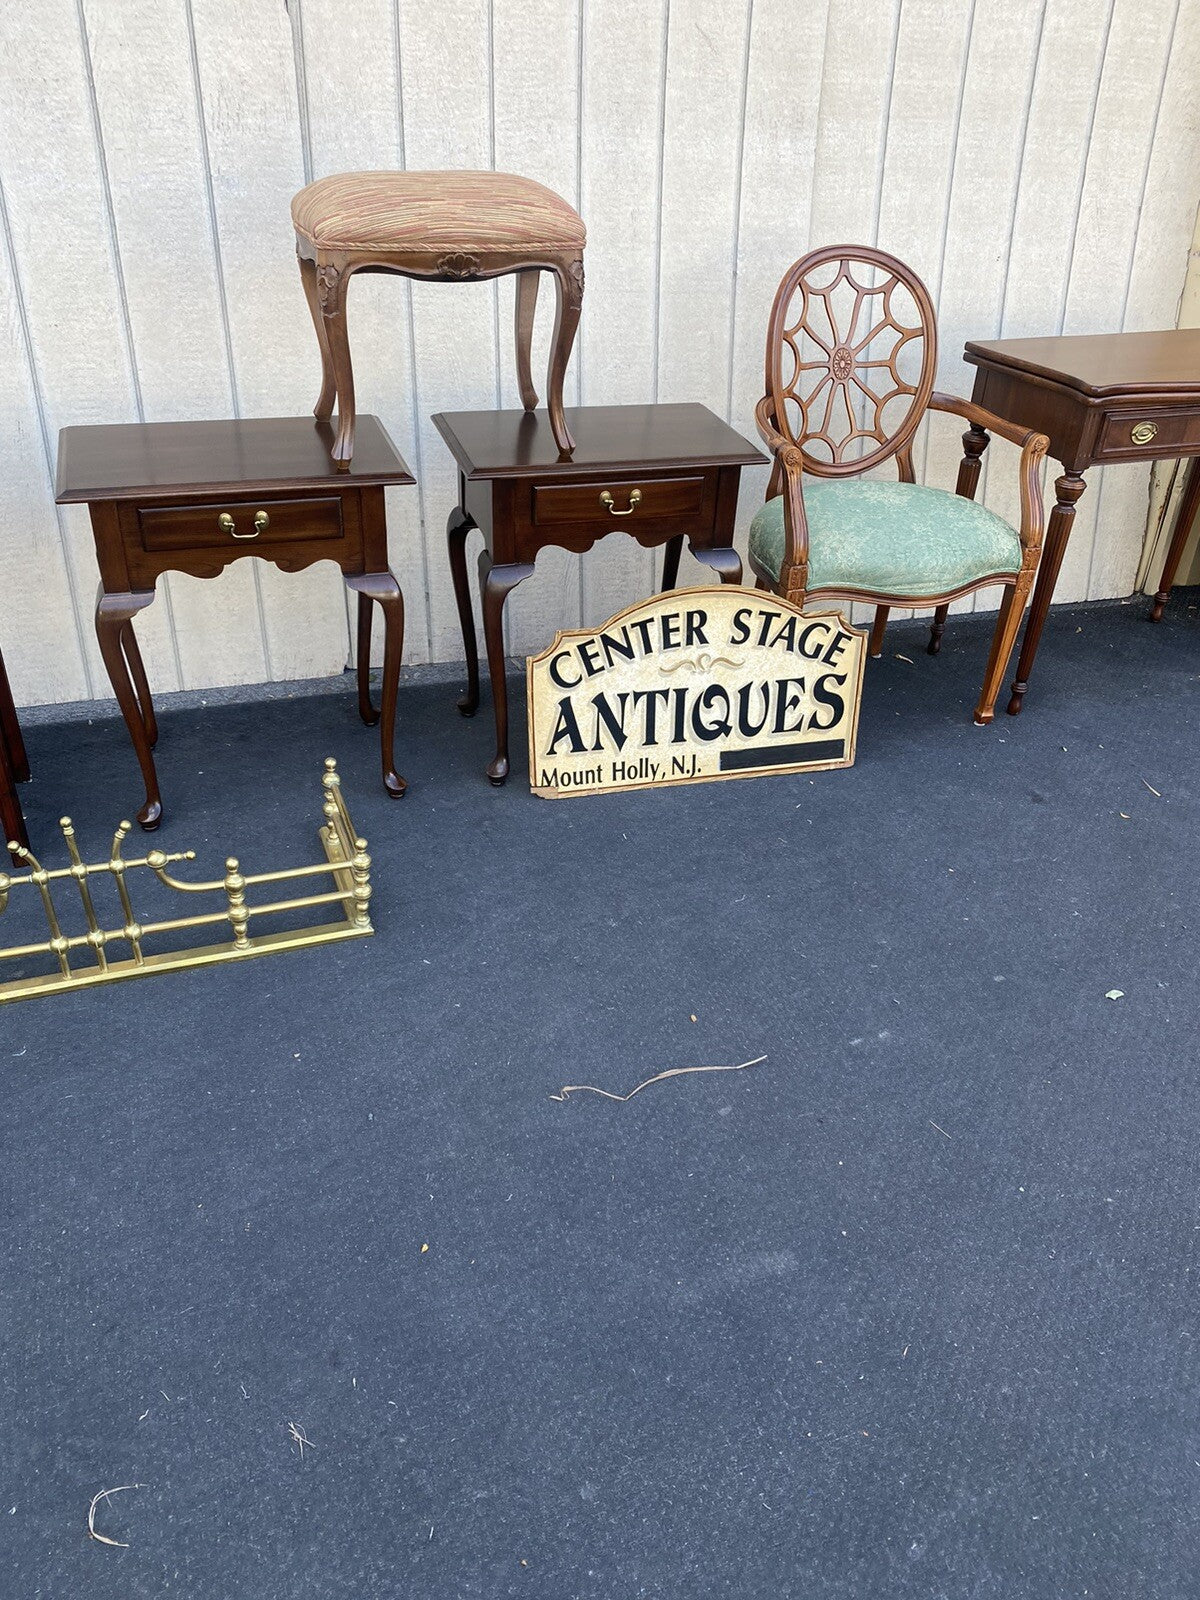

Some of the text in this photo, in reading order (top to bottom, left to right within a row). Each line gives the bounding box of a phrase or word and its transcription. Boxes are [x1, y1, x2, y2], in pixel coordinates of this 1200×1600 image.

[549, 608, 853, 689] CENTER STAGE
[545, 673, 849, 756] ANTIQUES
[541, 754, 702, 788] Mount Holly, N.J.
